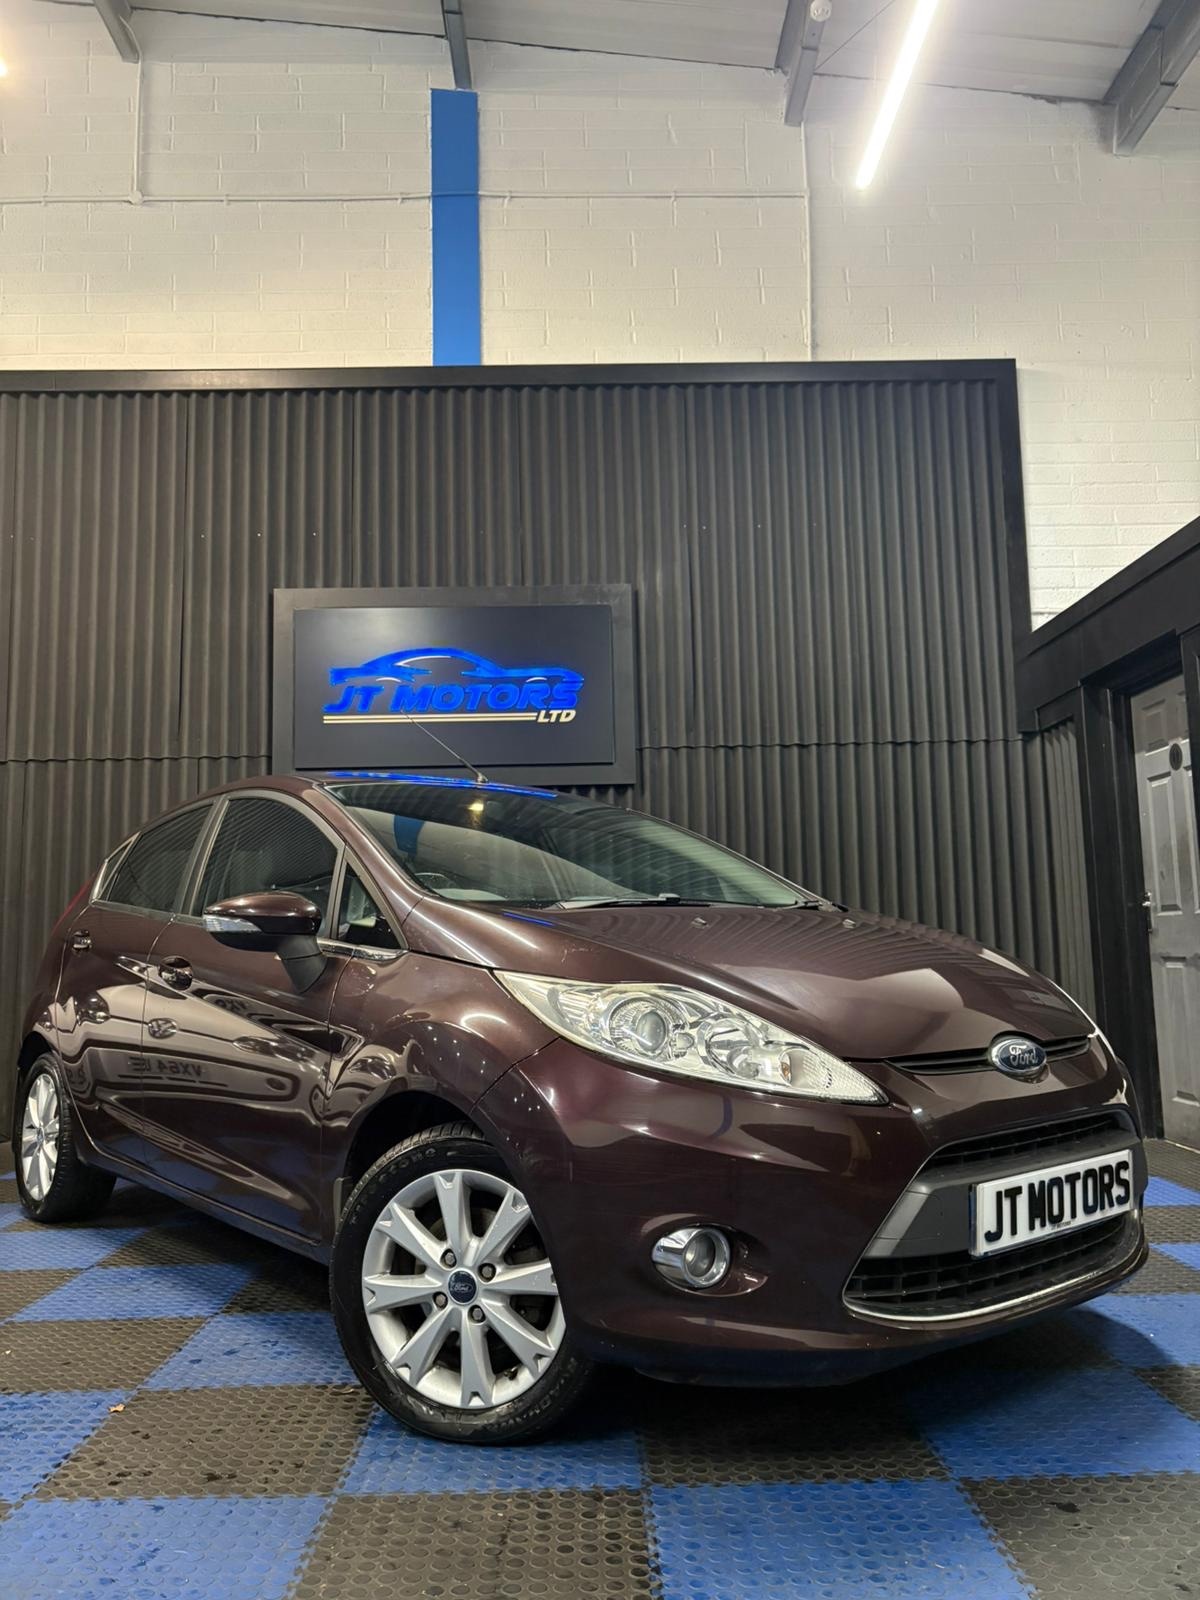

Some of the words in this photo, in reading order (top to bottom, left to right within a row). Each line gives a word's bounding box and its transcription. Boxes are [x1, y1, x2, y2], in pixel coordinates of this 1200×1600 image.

[323, 685, 385, 713] JT
[389, 682, 584, 713] MOTORS
[537, 709, 577, 723] LTD
[1009, 1044, 1039, 1067] Ford
[984, 1186, 1023, 1242] JT
[1027, 1160, 1131, 1231] MOTORS
